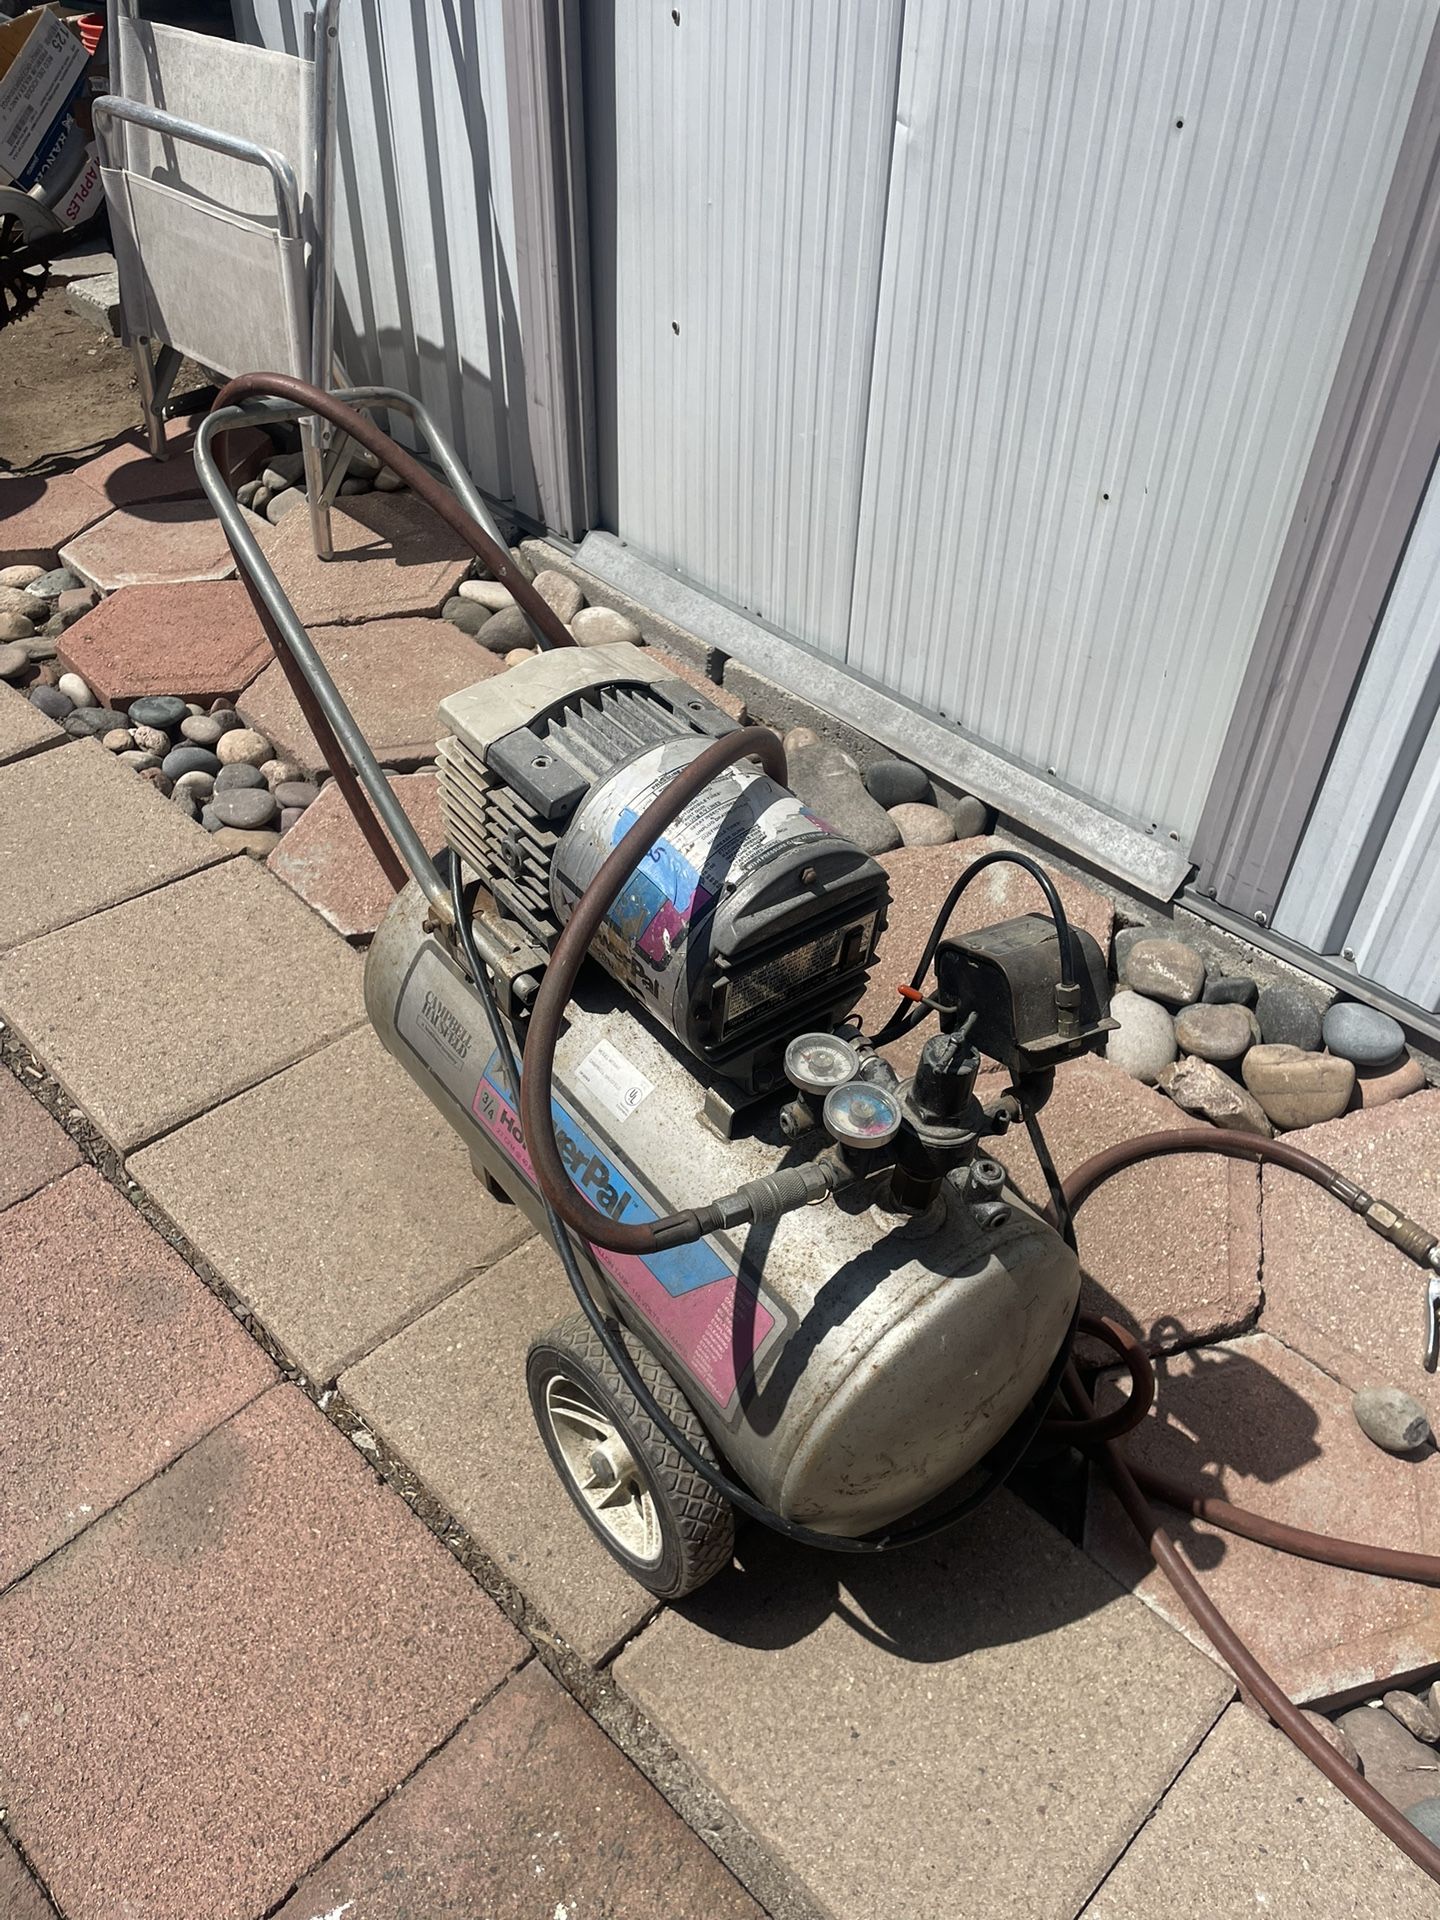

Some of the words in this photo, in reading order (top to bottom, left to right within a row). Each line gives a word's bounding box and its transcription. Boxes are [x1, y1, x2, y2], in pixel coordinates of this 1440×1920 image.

[50, 26, 70, 53] 125
[64, 165, 99, 221] APPLES
[651, 769, 680, 790] PRESSURE
[761, 842, 787, 860] PRESSURE
[420, 1001, 468, 1059] HAUSFELD
[424, 990, 473, 1049] CAMPBELL
[479, 1091, 496, 1119] 3/4
[628, 1088, 638, 1104] UL
[639, 1297, 660, 1324] VOLTS
